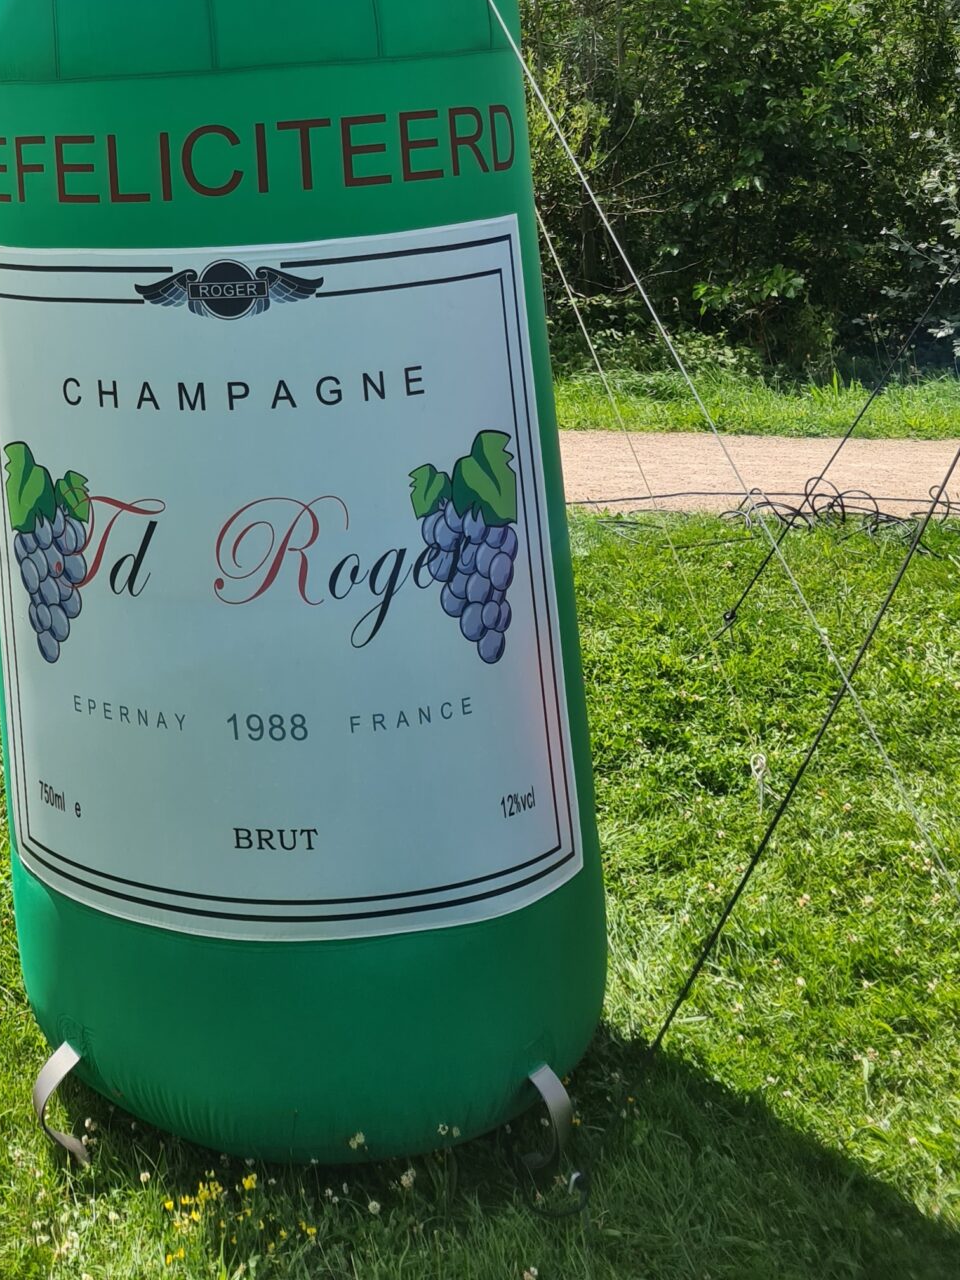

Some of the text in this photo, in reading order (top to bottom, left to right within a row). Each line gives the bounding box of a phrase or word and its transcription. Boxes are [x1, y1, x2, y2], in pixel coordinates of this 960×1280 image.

[199, 283, 258, 298] ROGER
[62, 365, 426, 411] CHAMPAGNE
[73, 694, 474, 742] EPERNAY 1988 FRANCE
[38, 779, 66, 812] 750ml
[232, 827, 319, 851] BRUT
